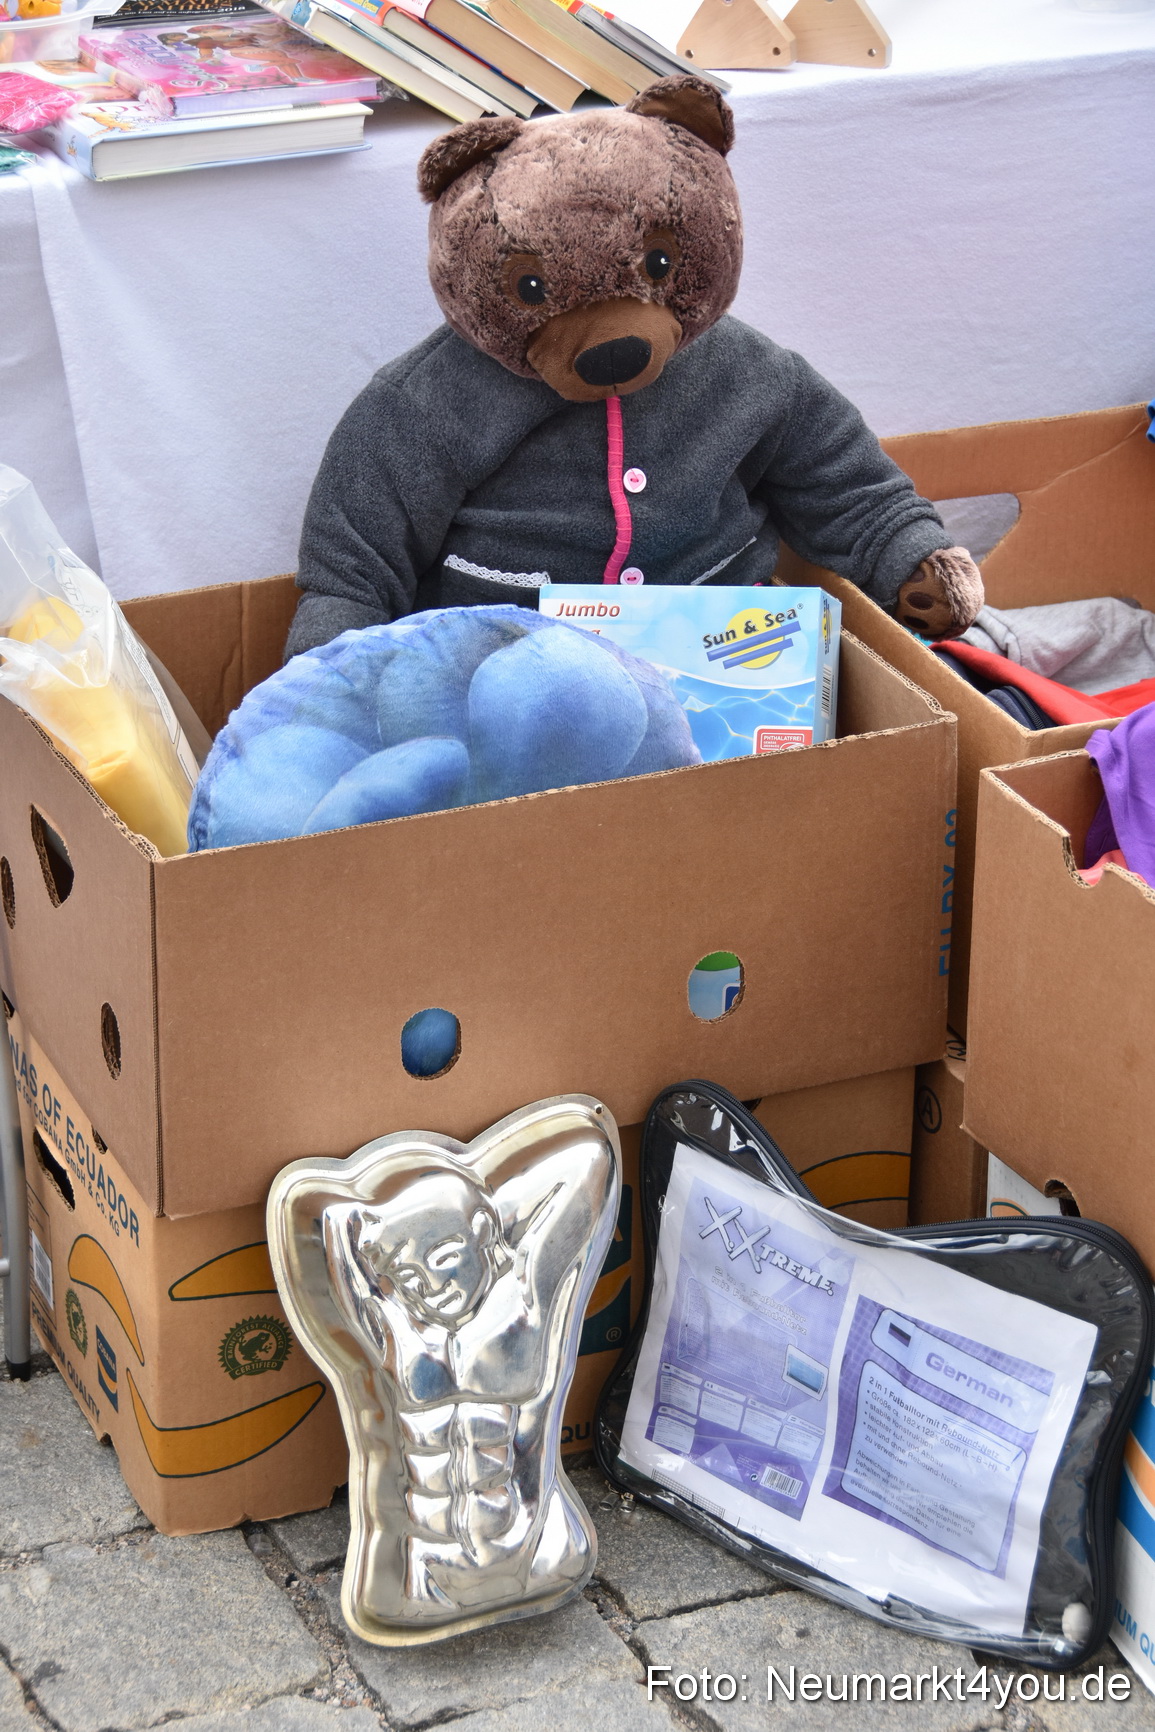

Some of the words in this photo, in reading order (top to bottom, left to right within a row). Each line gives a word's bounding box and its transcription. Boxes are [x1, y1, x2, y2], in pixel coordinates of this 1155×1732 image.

[556, 602, 620, 617] Jumbo
[702, 628, 738, 649] Sun
[744, 620, 758, 635] &
[764, 608, 798, 628] Sea
[22, 1086, 32, 1110] for
[34, 1102, 62, 1151] COBANA
[65, 1150, 86, 1188] GmbH
[88, 1181, 94, 1196] &
[96, 1192, 107, 1219] Co.
[109, 1211, 120, 1237] KG
[42, 1083, 62, 1126] OF
[66, 1115, 140, 1248] ECUADOR
[228, 1323, 259, 1358] RAINFOREST
[262, 1323, 284, 1348] ALLIANCE
[68, 1360, 100, 1424] QUALITY
[235, 1361, 278, 1376] CERTIFIED
[925, 1352, 1014, 1408] German
[867, 1376, 875, 1384] 2
[873, 1381, 883, 1390] in
[925, 1414, 941, 1428] mit
[868, 1402, 892, 1422] stabile
[890, 1418, 934, 1449] Konstruktion
[870, 1391, 892, 1411] Größe
[891, 1408, 902, 1418] ca.
[901, 1415, 917, 1427] 182
[920, 1426, 936, 1438] 122
[938, 1436, 961, 1453] 60cm
[863, 1434, 873, 1444] zu
[871, 1440, 909, 1467] verwenden
[866, 1413, 892, 1433] leichter
[904, 1439, 920, 1452] und
[866, 1423, 878, 1435] mit
[876, 1432, 892, 1444] und
[889, 1441, 908, 1456] ohne
[906, 1451, 959, 1487] Rebound-Netz
[854, 1458, 881, 1480] behalten
[962, 1526, 973, 1535] die
[856, 1449, 899, 1482] Abweichungen
[938, 1503, 976, 1528] Gestaltung
[914, 1508, 935, 1523] Daten
[934, 1519, 946, 1529] für
